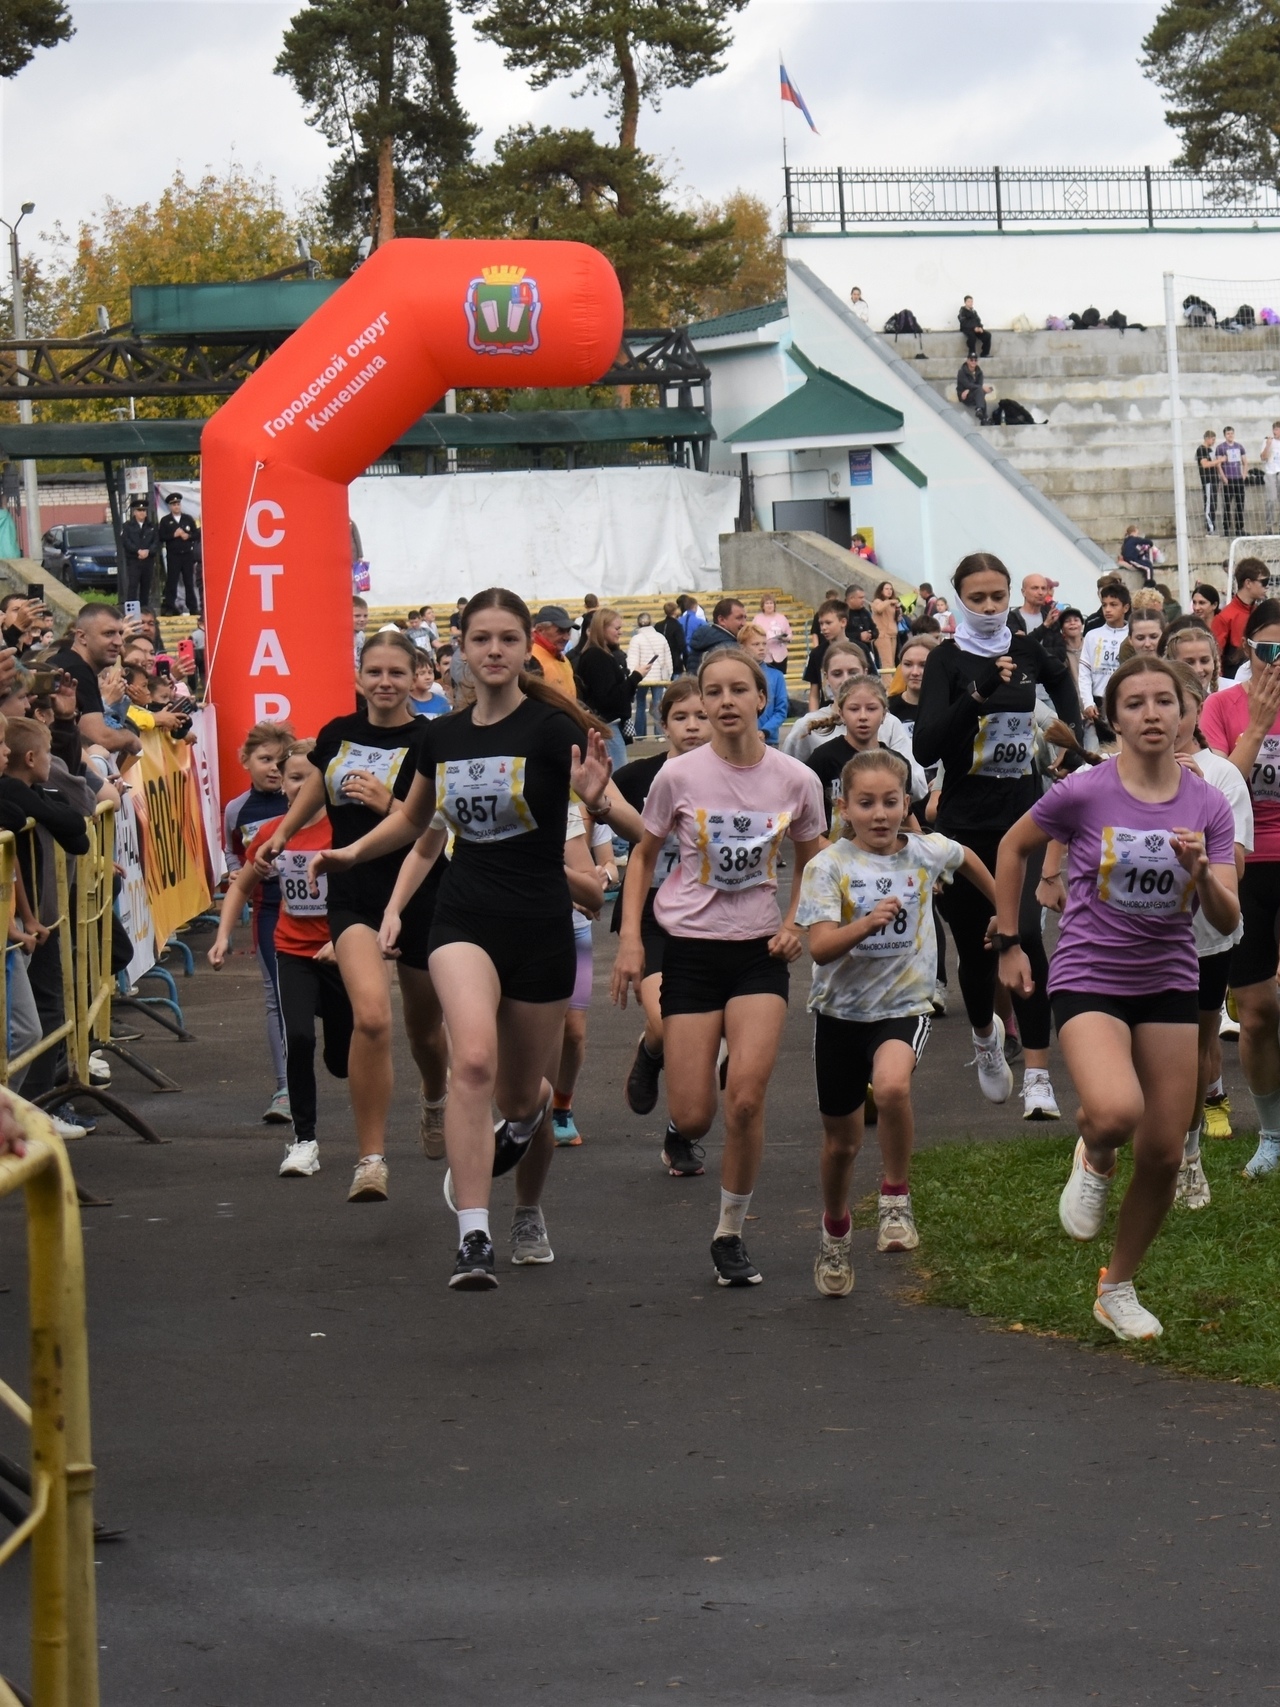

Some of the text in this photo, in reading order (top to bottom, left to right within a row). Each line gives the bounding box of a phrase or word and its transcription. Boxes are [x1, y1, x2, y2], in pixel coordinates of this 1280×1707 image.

[263, 311, 390, 438] Городской округ
[305, 355, 387, 432] Кинешма
[993, 742, 1027, 763] 698
[455, 794, 498, 825] 857
[719, 846, 762, 873] 383
[1124, 867, 1175, 895] 160
